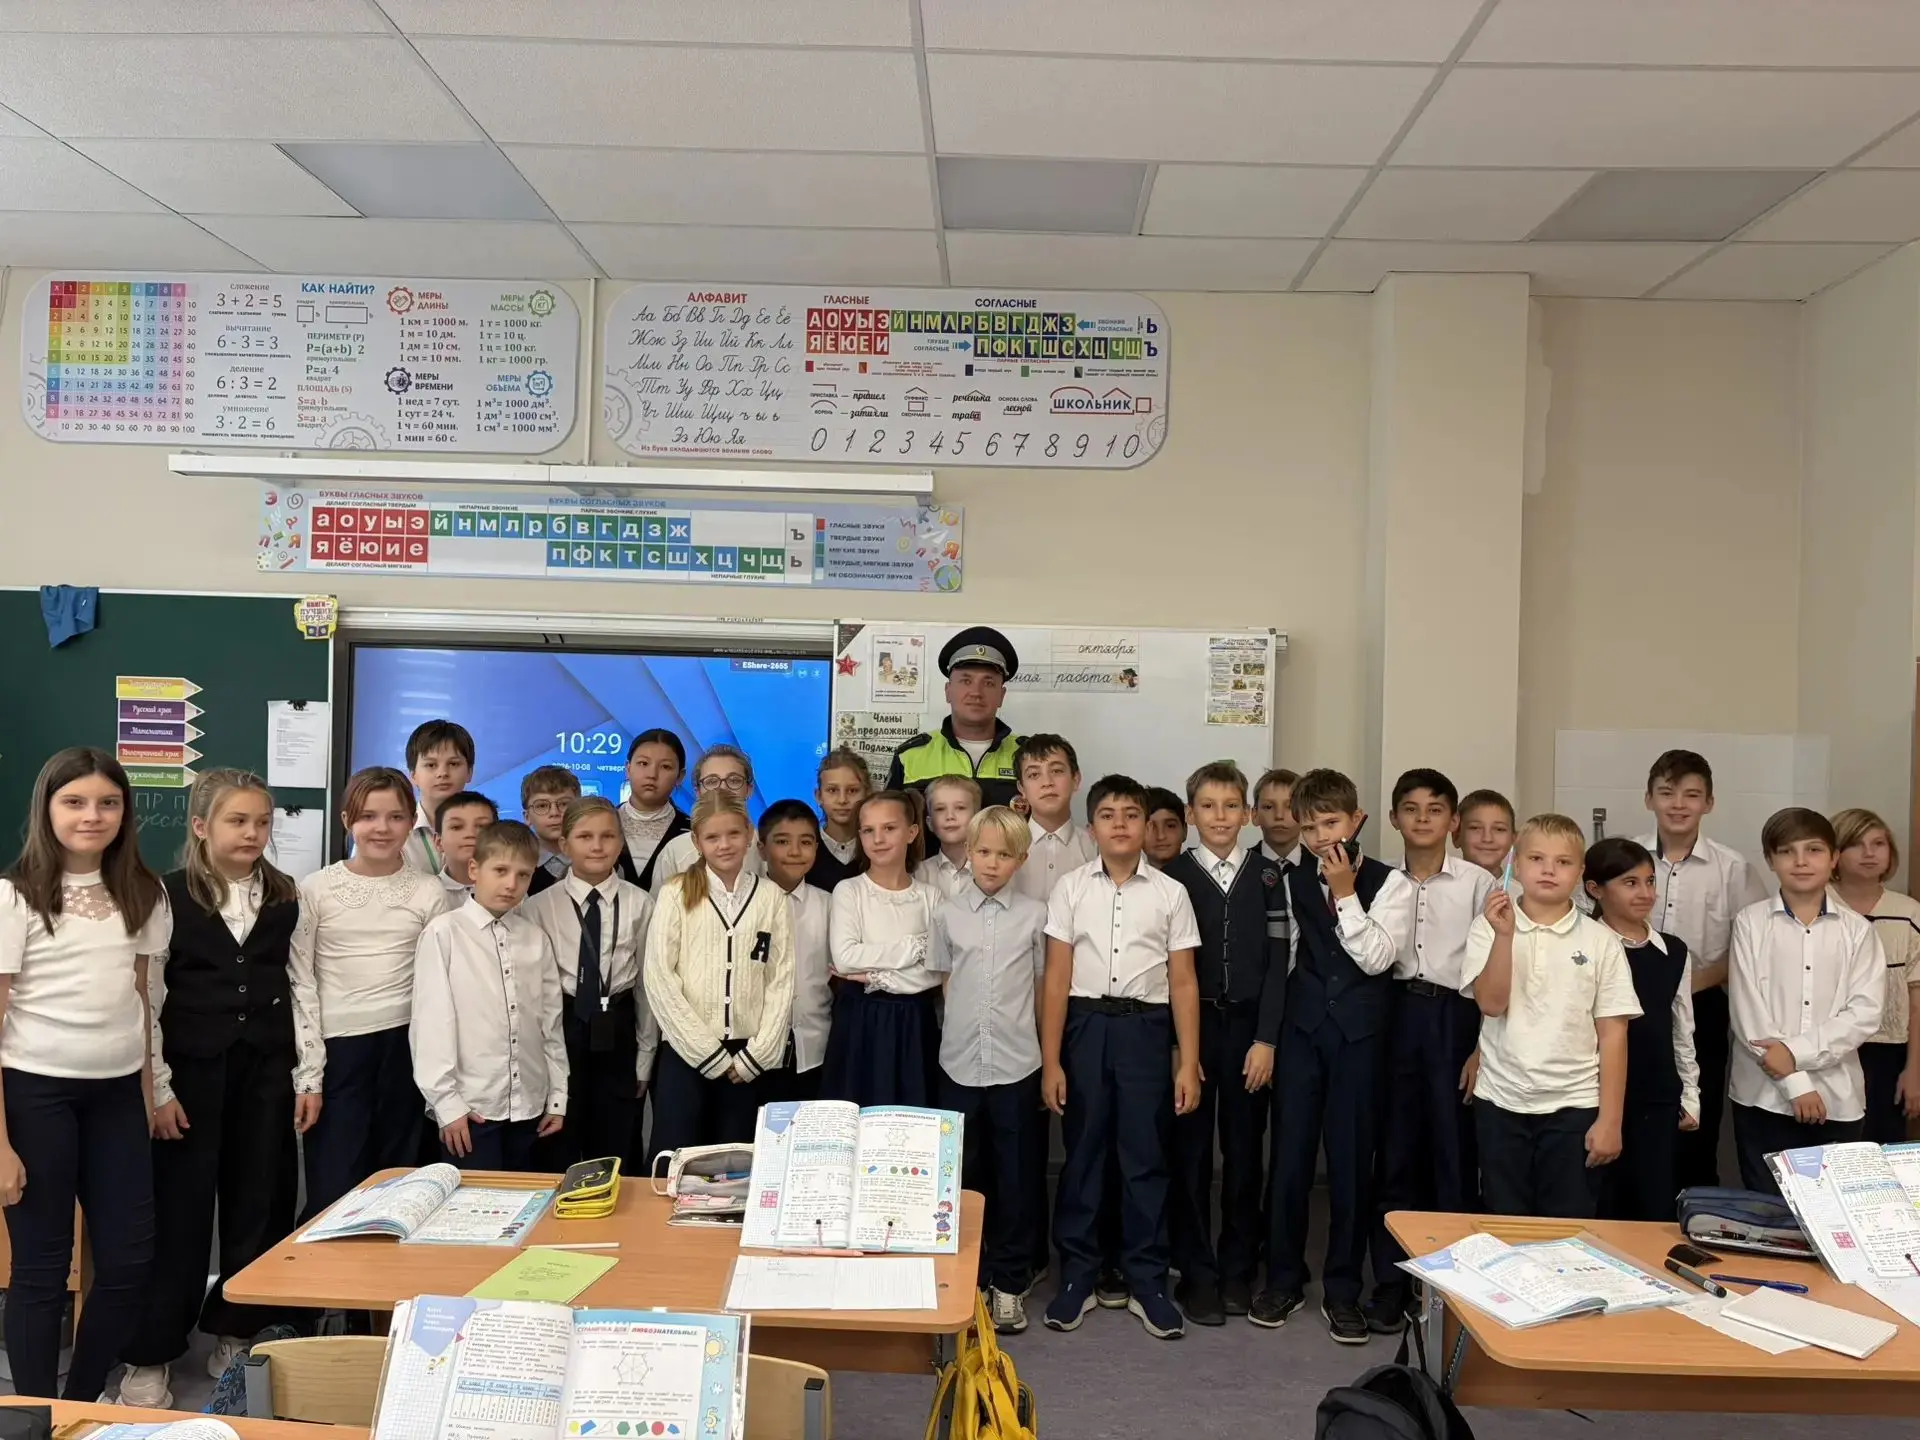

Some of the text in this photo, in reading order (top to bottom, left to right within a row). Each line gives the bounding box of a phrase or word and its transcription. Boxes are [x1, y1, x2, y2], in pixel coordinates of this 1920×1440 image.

[302, 283, 375, 295] КАК НАЙТИ?
[217, 293, 225, 306] 3
[245, 294, 253, 307] 2
[273, 295, 281, 308] 5
[687, 293, 747, 303] АЛФАВИТ
[824, 296, 869, 304] ГЛАСНЫЕ
[975, 299, 1037, 308] СОГЛАСНЫЕ
[632, 306, 656, 321] Аа
[662, 305, 688, 321] Бб
[433, 318, 455, 326] 1000
[504, 320, 527, 328] 1000
[486, 384, 520, 392] ОБЪЕМА
[1004, 404, 1032, 412] лесной
[1053, 399, 1131, 410] ШКОЛЬНИК
[811, 428, 1140, 459] 0 1 2 3 4 5 6 7 8 9 10
[580, 498, 632, 506] СОГЛАСНЫХ
[1078, 639, 1135, 659] октября
[742, 662, 789, 670] EShare-2655
[1054, 667, 1112, 688] работа
[132, 705, 156, 715] Русский
[873, 713, 902, 722] Члены
[130, 727, 173, 735] Математика
[858, 728, 918, 736] предложения
[556, 732, 622, 754] 10:29
[859, 741, 898, 752] Подлеж
[135, 792, 163, 809] ПР
